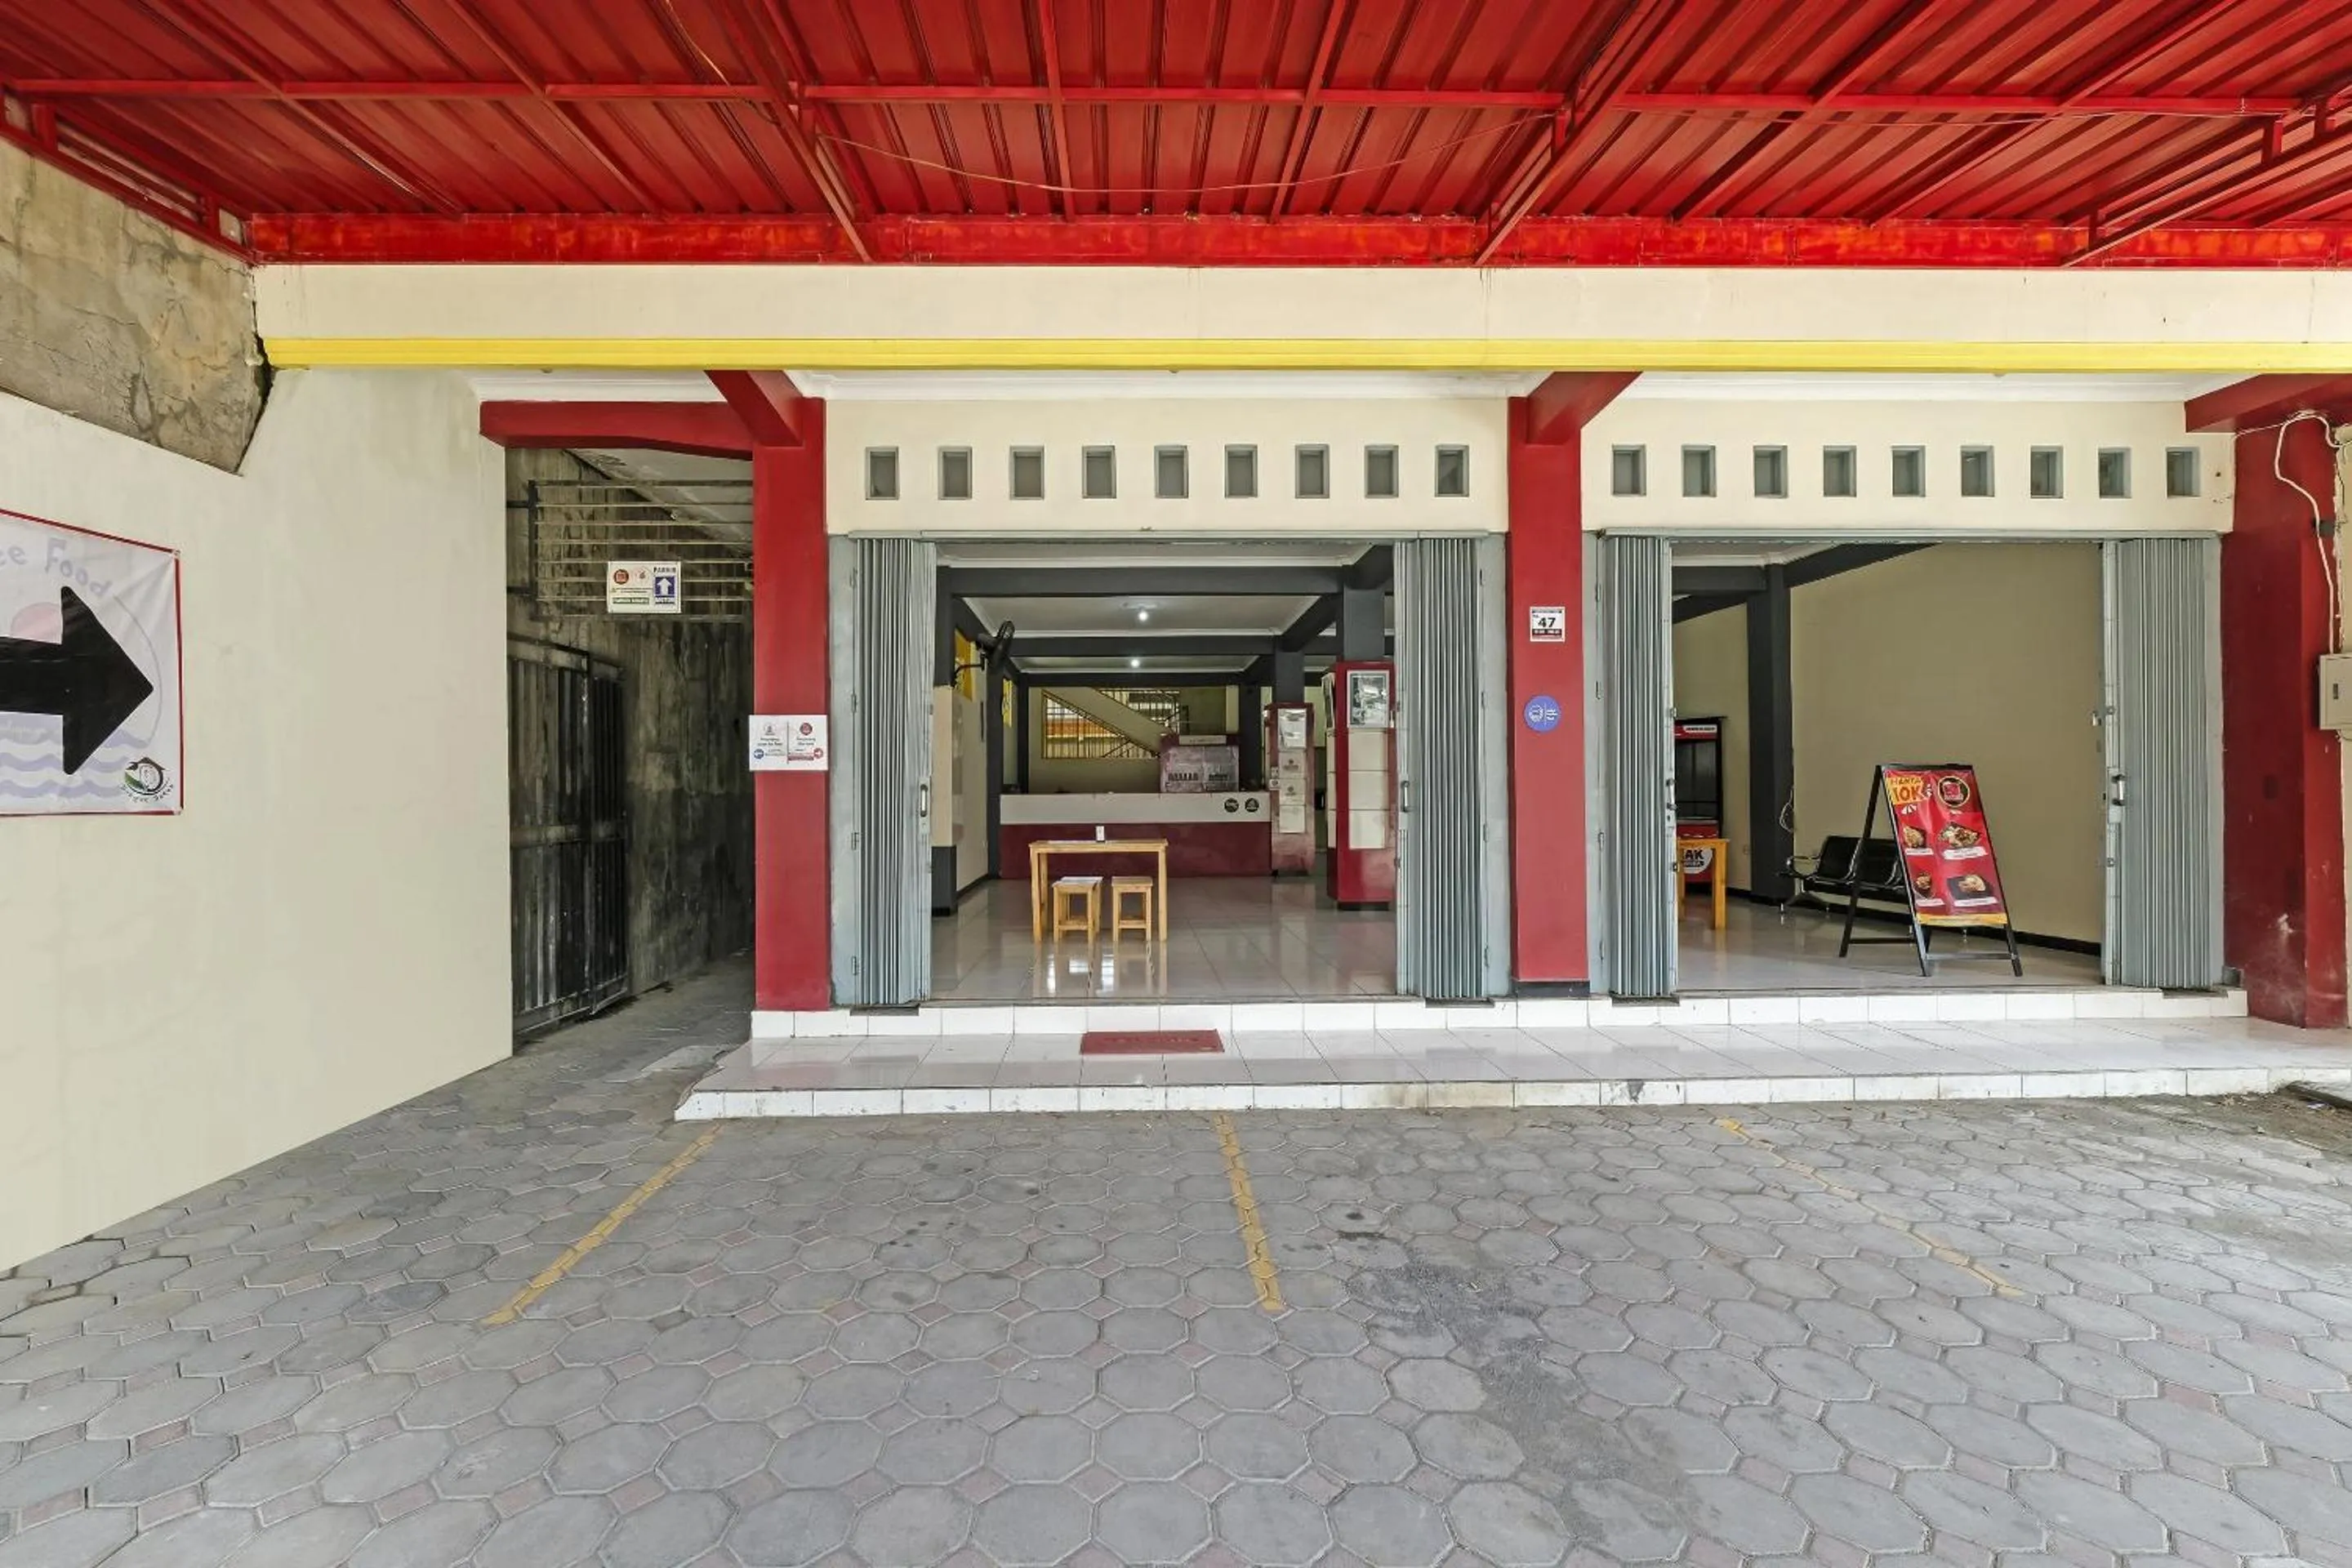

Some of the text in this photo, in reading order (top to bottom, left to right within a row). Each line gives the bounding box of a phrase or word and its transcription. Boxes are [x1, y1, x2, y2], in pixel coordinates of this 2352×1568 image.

[44, 537, 113, 597] Food
[1538, 617, 1557, 628] 47
[1892, 786, 1922, 801] 10K
